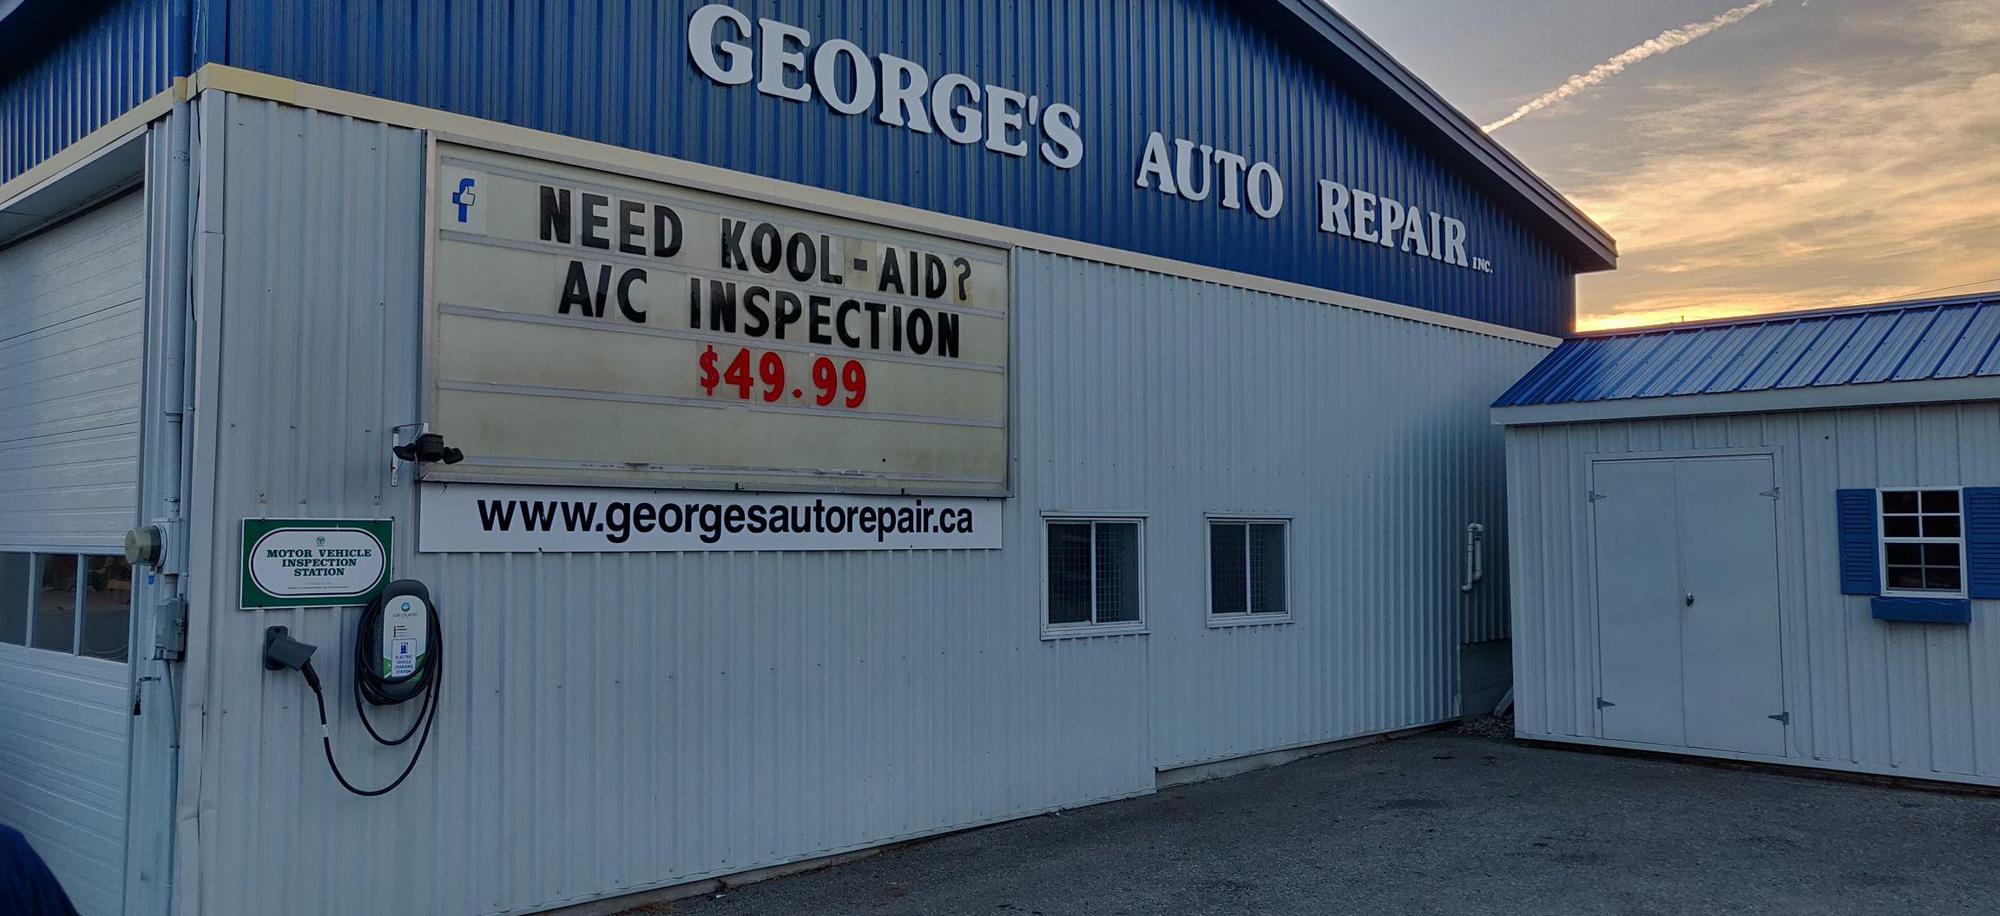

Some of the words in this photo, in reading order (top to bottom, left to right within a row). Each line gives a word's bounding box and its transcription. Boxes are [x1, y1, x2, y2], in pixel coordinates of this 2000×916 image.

[688, 5, 1083, 169] GEORGE'S
[1137, 132, 1283, 219] AUTO
[1319, 179, 1467, 268] REPAIR
[1472, 256, 1493, 274] INC.
[539, 186, 683, 258] NEED
[558, 260, 648, 324] A/C
[690, 277, 959, 358] INSPECTION
[698, 342, 867, 408] $49.99
[477, 499, 974, 542] www.georgesautorepair.ca
[267, 549, 312, 558] MOTOR
[318, 549, 372, 558] VEHICLE
[282, 558, 357, 567] INSPECTION
[293, 568, 345, 577] STATION
